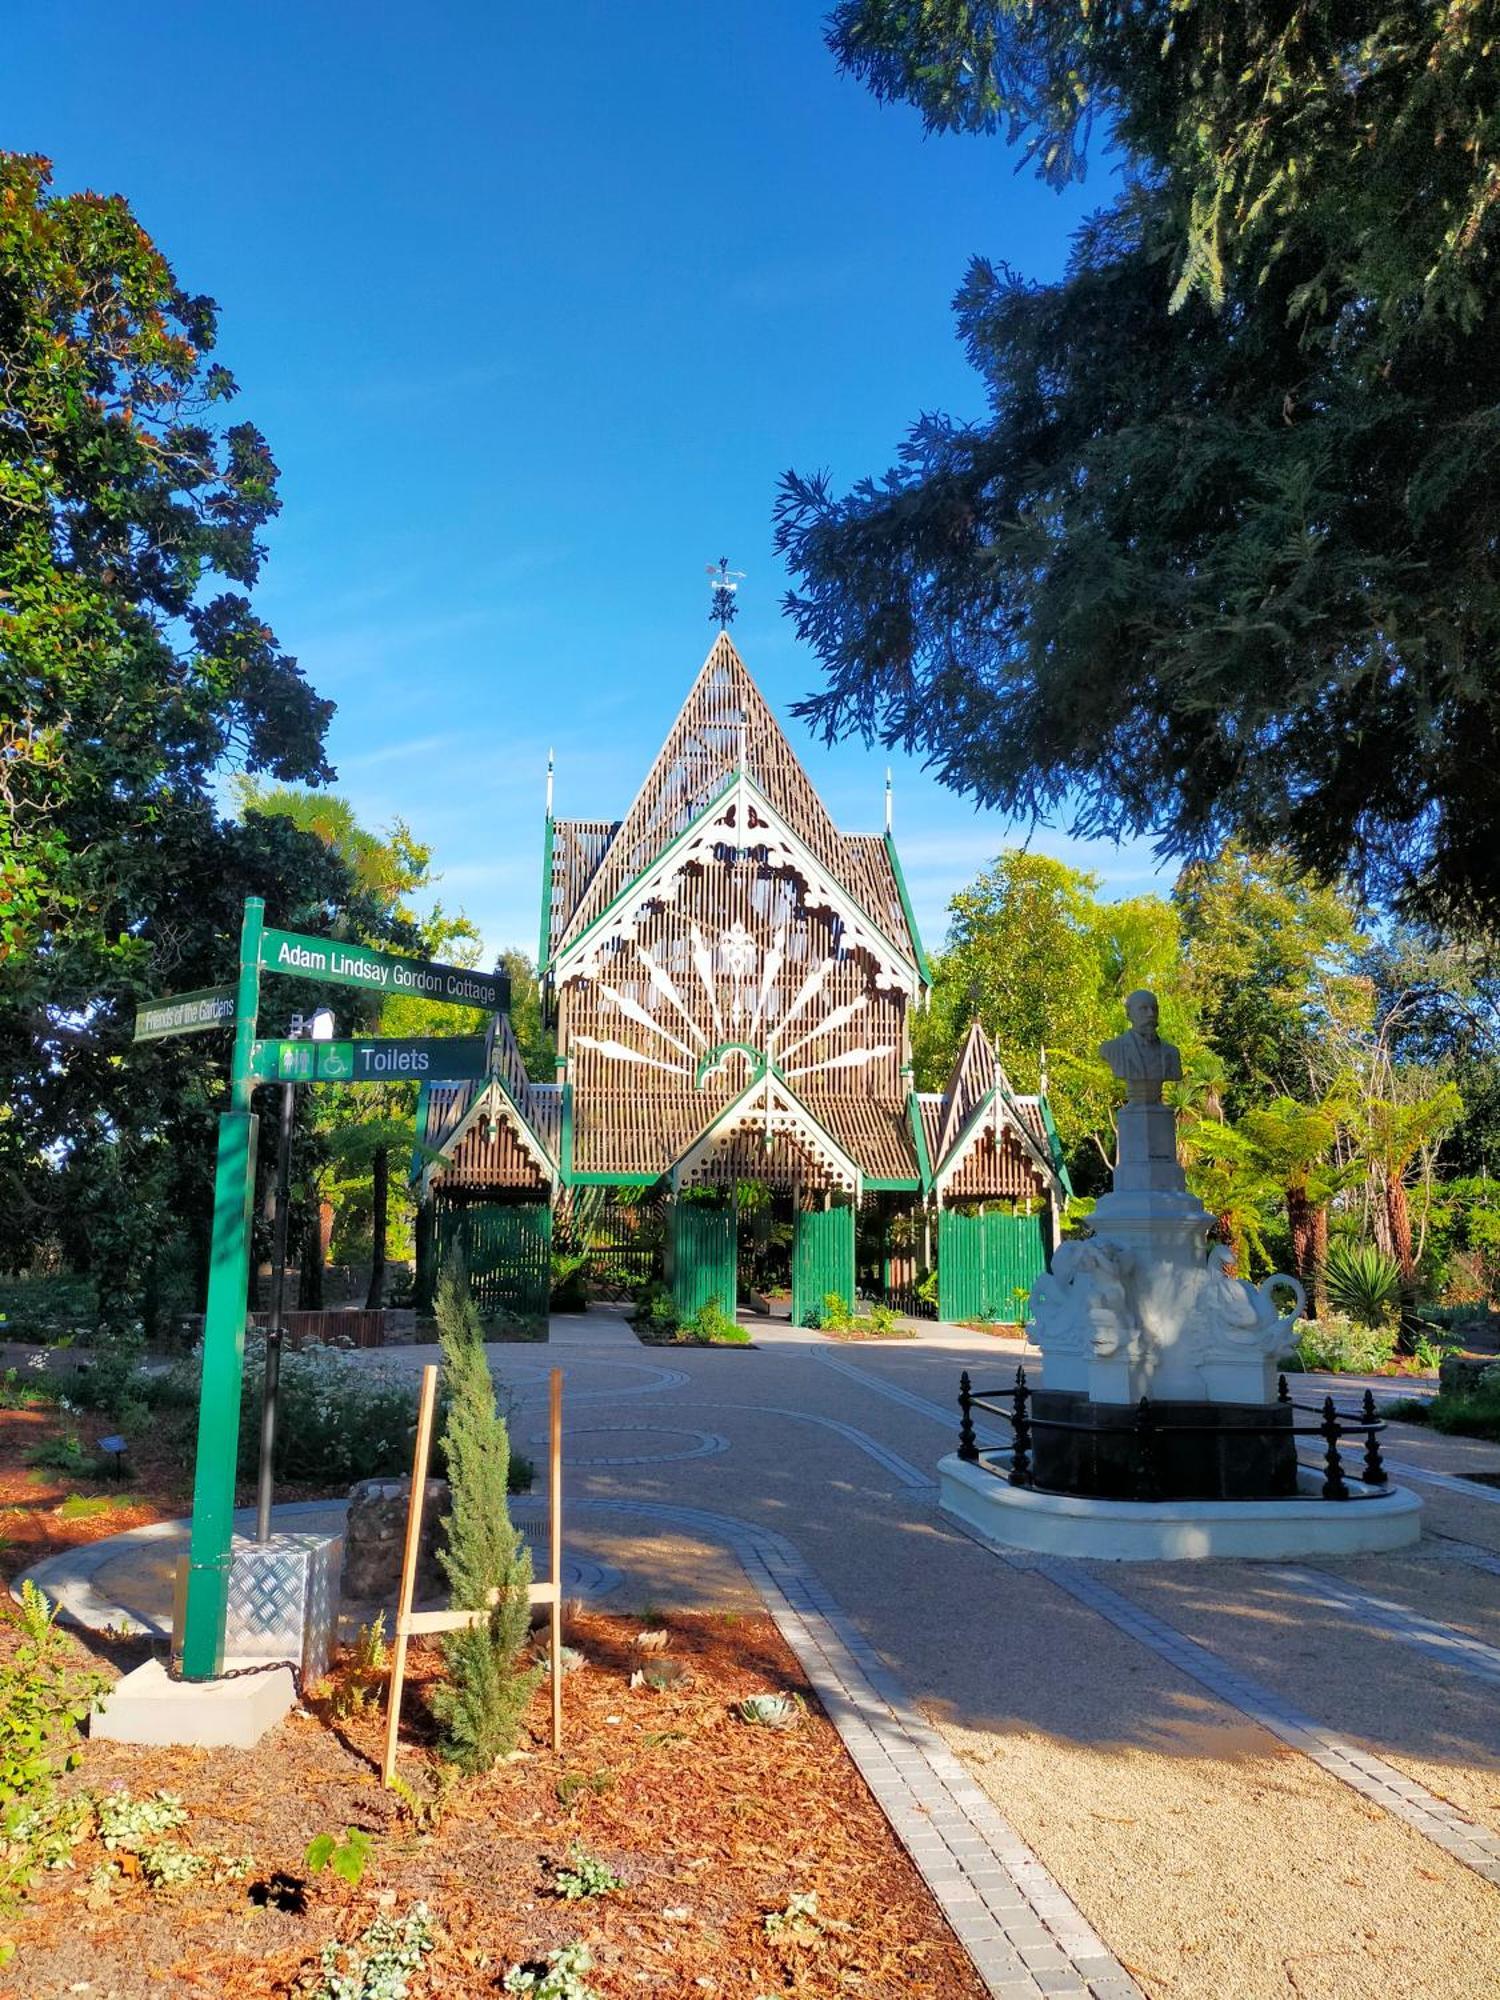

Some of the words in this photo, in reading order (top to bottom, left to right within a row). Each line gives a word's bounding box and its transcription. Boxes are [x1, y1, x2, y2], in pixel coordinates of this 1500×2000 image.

[278, 942, 326, 970] Adam
[331, 952, 389, 986] Lindsay
[393, 965, 442, 992] Gordon
[446, 975, 497, 1005] Cottage
[145, 1006, 174, 1030] Friends
[174, 1004, 185, 1025] of
[185, 1003, 199, 1024] the
[199, 997, 234, 1020] Gardens
[361, 1048, 429, 1071] Toilets
